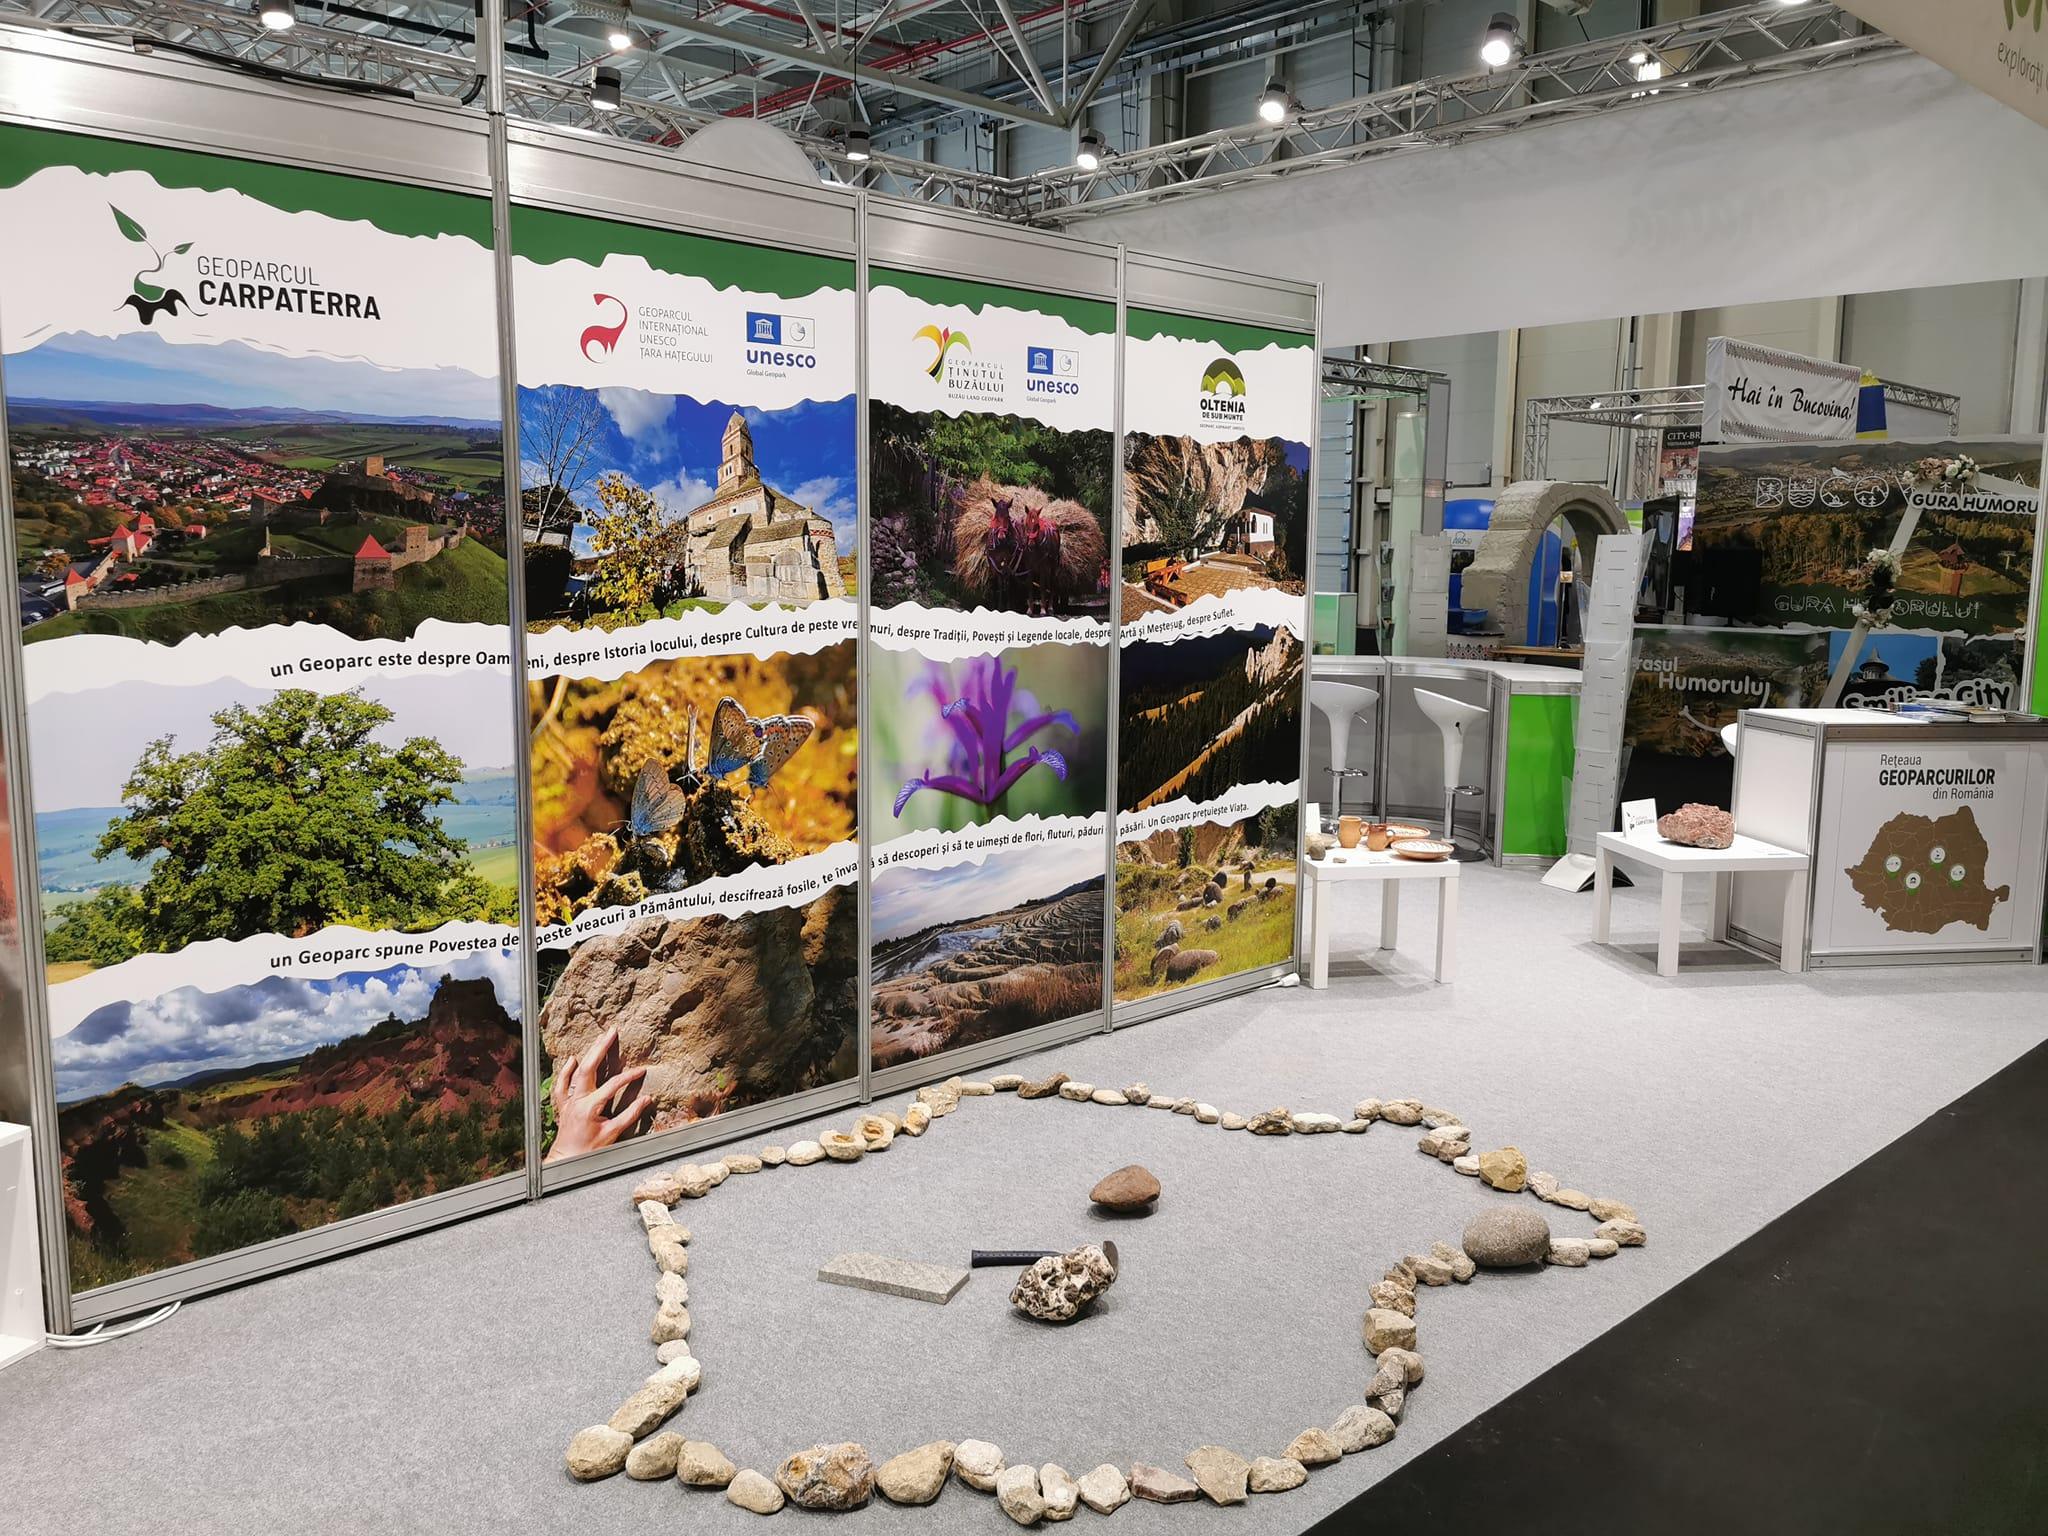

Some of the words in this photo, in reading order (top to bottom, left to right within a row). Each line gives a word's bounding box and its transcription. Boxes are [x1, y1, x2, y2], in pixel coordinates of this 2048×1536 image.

[197, 255, 320, 287] GEOPARCUL
[199, 279, 381, 320] CARPATERRA
[638, 306, 693, 321] GEOPARCUL
[639, 333, 677, 347] UNESCO
[746, 349, 816, 369] unesco
[948, 358, 1004, 370] GEOPARCUL
[746, 368, 764, 377] Global
[764, 370, 787, 379] Geopark
[1026, 379, 1079, 395] unesco
[1200, 398, 1246, 414] OLTENIA
[1728, 376, 1762, 405] Hai
[1767, 385, 1783, 409] în
[1790, 387, 1856, 420] Bucovina!
[1202, 411, 1210, 419] DE
[1211, 412, 1223, 420] SUB
[1912, 493, 1959, 509] GURA
[1962, 496, 2039, 514] HUMORU
[270, 663, 294, 678] un
[299, 656, 373, 673] Geoparc
[378, 653, 412, 667] este
[417, 650, 471, 668] despre
[553, 651, 600, 666] despre
[604, 642, 647, 660] Istoria
[650, 634, 697, 653] locului,
[700, 631, 742, 646] despre
[745, 625, 788, 639] Cultura
[791, 621, 805, 633] de
[808, 620, 839, 634] peste
[897, 625, 931, 640] despre
[933, 628, 970, 643] Tradiții,
[972, 630, 1005, 643] Povești
[1007, 633, 1015, 643] și
[1017, 630, 1053, 645] Legende
[1055, 629, 1084, 643] locale,
[1085, 628, 1111, 640] despre
[1119, 626, 1137, 640] Artă
[1138, 626, 1145, 638] și
[1147, 620, 1185, 635] Meșteșug,
[1187, 614, 1211, 626] despre
[1213, 608, 1233, 621] Suflet.
[1879, 753, 1922, 768] Rețeaua
[1878, 768, 1996, 786] GEOPARCURILOR
[1932, 787, 1948, 800] din
[1950, 786, 1994, 800] România
[270, 955, 292, 969] un
[298, 947, 370, 965] Geoparc
[375, 943, 424, 960] spune
[429, 937, 497, 953] Povestea
[501, 933, 519, 948] de
[536, 921, 573, 948] peste
[575, 909, 625, 933] veacuri
[628, 908, 637, 920] a
[640, 892, 716, 917] Pământului,
[719, 885, 784, 903] descifrează
[786, 879, 821, 897] fosile,
[822, 873, 834, 884] te
[877, 853, 889, 866] să
[891, 843, 939, 862] descoperi
[941, 842, 950, 856] și
[952, 840, 962, 852] să
[964, 840, 974, 850] te
[976, 834, 1010, 848] uimești
[1011, 833, 1023, 844] de
[1025, 831, 1045, 842] flori,
[1047, 829, 1075, 840] fluturi,
[1077, 825, 1104, 839] păduri
[1120, 822, 1146, 837] păsări.
[1148, 818, 1159, 828] Un
[1160, 812, 1190, 826] Geoparc
[1192, 807, 1228, 822] prețuiește
[1229, 802, 1249, 815] Viața.
